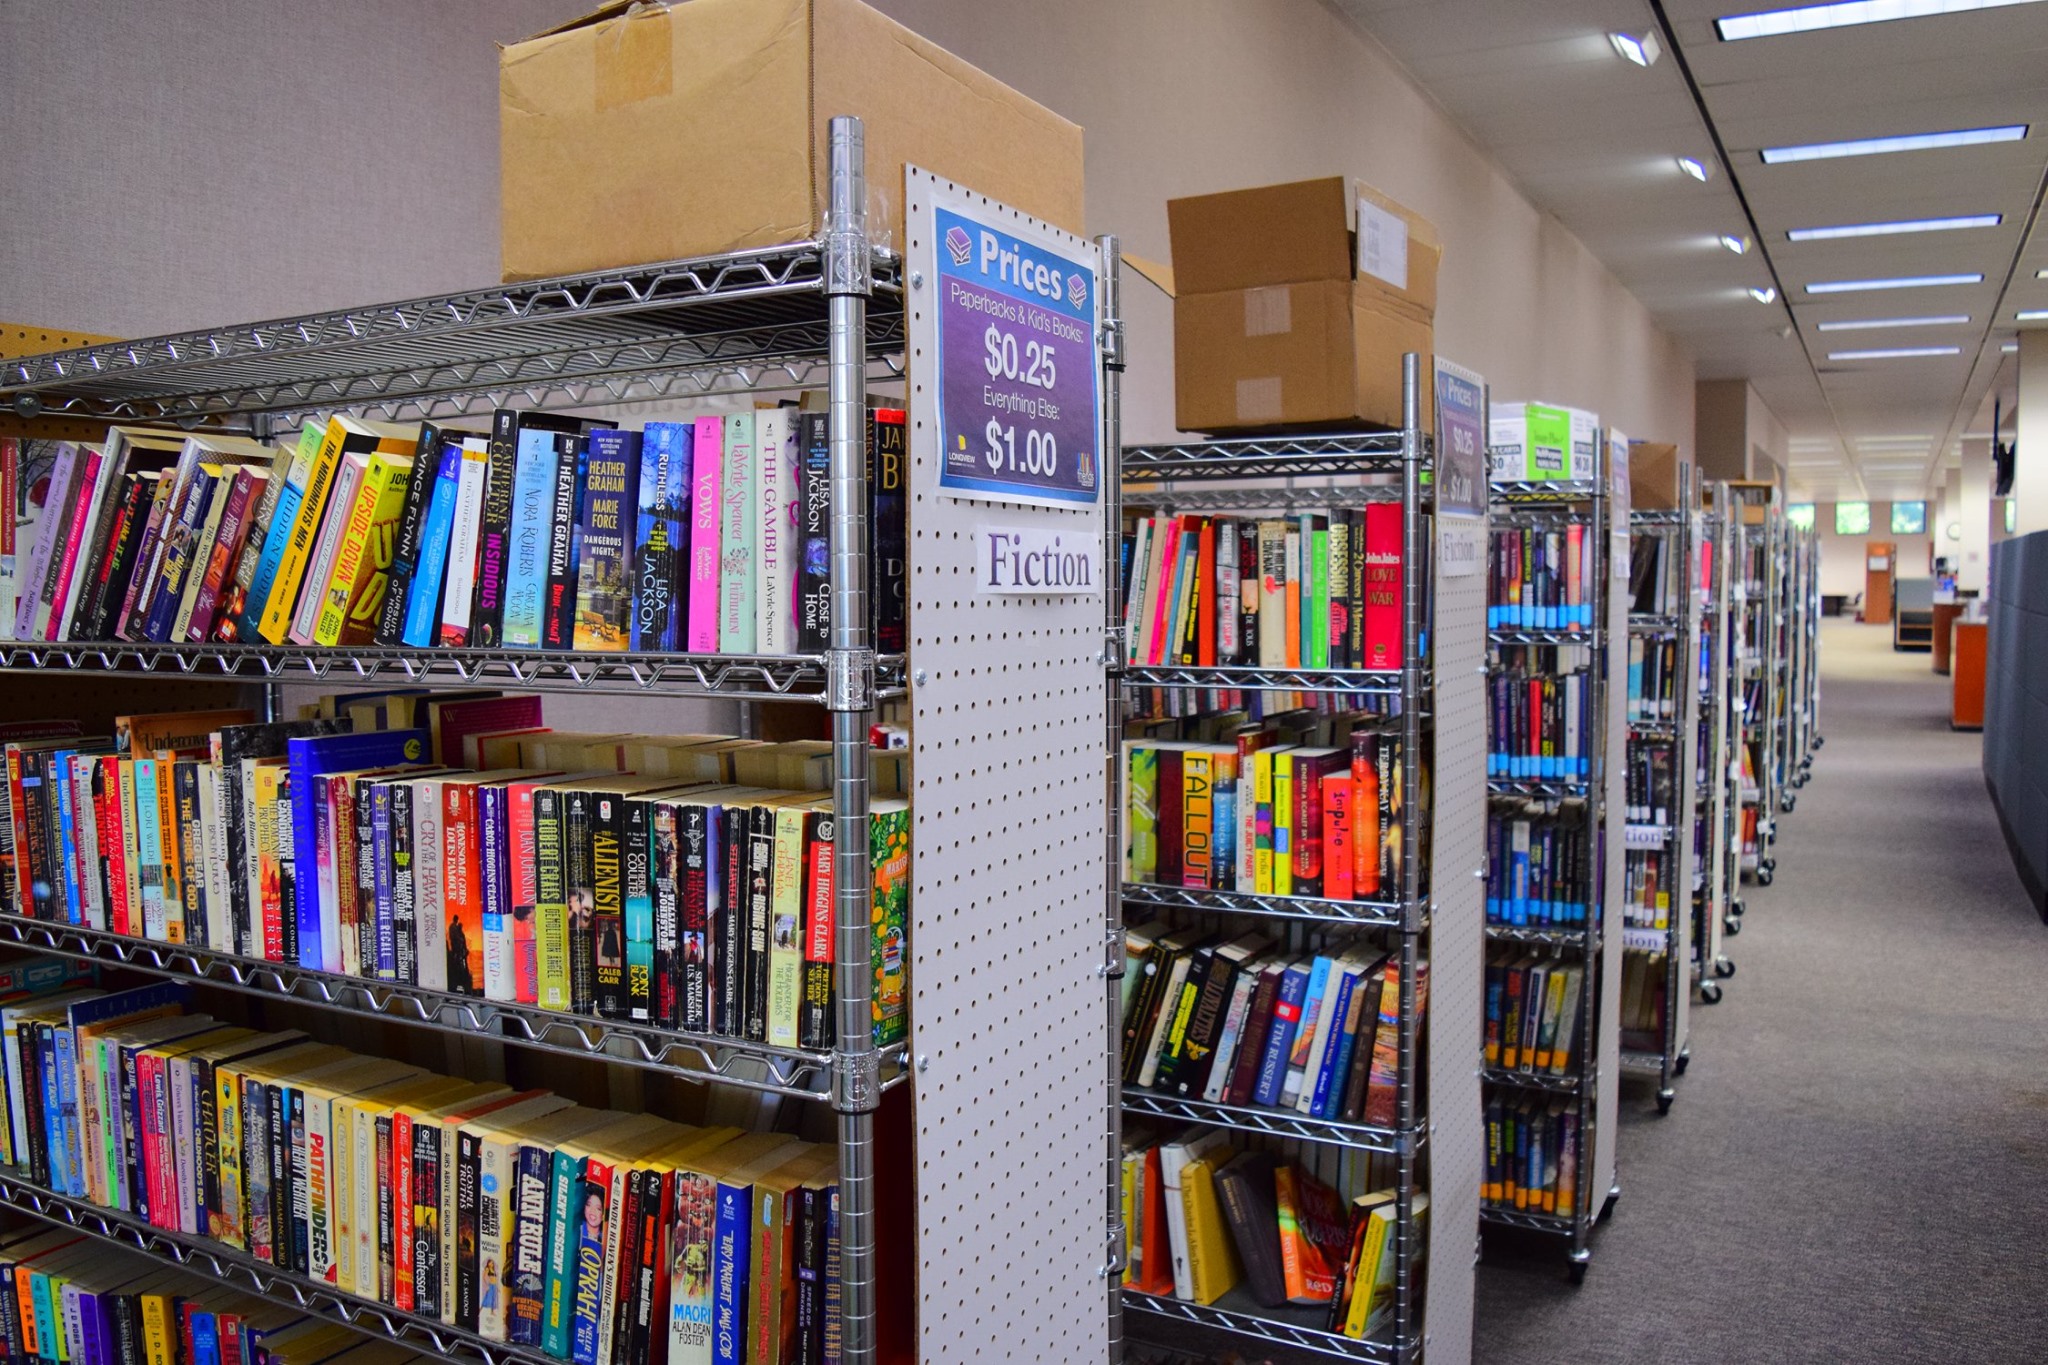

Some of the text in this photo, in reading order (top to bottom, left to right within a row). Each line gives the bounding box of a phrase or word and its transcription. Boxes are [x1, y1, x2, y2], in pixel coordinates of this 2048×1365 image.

[980, 230, 1062, 302] Prices
[951, 283, 1084, 344] Paperbacks & Kid's Books:
[984, 323, 1057, 391] $0.25
[983, 385, 1060, 420] Everything Else:
[1447, 380, 1472, 407] Prices
[294, 433, 316, 483] KEPNES
[948, 452, 976, 464] LONGVIEW
[985, 416, 1057, 477] $1.00
[1452, 427, 1474, 456] $0.25
[486, 441, 502, 524] COULTER
[502, 443, 513, 523] CATHERINE
[588, 461, 626, 477] HEATHER
[588, 476, 626, 492] GRAHAM
[656, 454, 669, 511] RUTHLESS
[1450, 474, 1472, 503] $1.00
[294, 441, 337, 552] THE MONUMENTS MEN
[400, 453, 429, 557] VINCE FLYNN
[592, 500, 620, 515] MARIE
[698, 473, 713, 529] VOWS
[807, 469, 823, 532] JACKSON
[819, 479, 830, 509] LISA
[337, 485, 377, 585] UPSIDE DOWN
[519, 488, 540, 577] NORA ROBERTS
[551, 465, 571, 577] HEATHER GRAHAM
[584, 535, 622, 546] DANGEROUS
[592, 514, 619, 530] FORCE
[764, 443, 777, 648] THE GAMBLE LaVyrle Spencer
[253, 494, 297, 613] HIDDEN BODIES
[482, 533, 500, 609] INSIDIOUS
[592, 546, 615, 556] NIGHTS
[987, 533, 1091, 587] Fiction
[1263, 540, 1274, 575] COVENANT
[1330, 523, 1349, 597] OBSESSION
[1366, 552, 1400, 564] John Jakes
[1443, 532, 1475, 562] Fiction
[640, 553, 656, 634] JACKSON
[655, 579, 668, 611] LISA
[1367, 568, 1398, 583] LOVE
[1368, 591, 1395, 605] WAR
[319, 611, 330, 632] MILLER
[323, 614, 335, 640] RAMSEY
[331, 617, 341, 637] JOHN
[382, 579, 400, 638] OF HONOR
[389, 587, 404, 635] PURSUIT
[804, 594, 818, 630] HOME
[818, 583, 831, 623] CLOSE
[1379, 745, 1389, 814] TERRY KAY
[144, 804, 155, 863] LORI WILDE
[158, 765, 172, 861] MODERN SPANISH THEATRE
[259, 806, 270, 855] PROPHECY
[1186, 757, 1208, 886] FALLOUT
[191, 819, 205, 888] GREG BEAR
[270, 818, 280, 862] ROMANOV
[538, 818, 560, 900] ROBERT CRAIS
[1219, 847, 1226, 857] AS
[1260, 851, 1269, 875] India
[485, 818, 497, 913] CAROL HIGGINS CLARK
[519, 829, 536, 904] JOAN JOHNSTON
[594, 834, 620, 917] ALIENIST
[628, 853, 638, 898] COULTER
[637, 853, 647, 898] CATHERINE
[775, 839, 787, 898] CHAPMAN
[785, 856, 796, 889] JANET
[1218, 860, 1226, 879] THIS
[1246, 854, 1254, 879] PARTS
[288, 888, 297, 958] RICHARD CONDON
[752, 894, 766, 952] RISING SUN
[812, 845, 832, 960] MARY HIGGINS CLARK
[266, 903, 277, 957] BERRY
[275, 903, 284, 955] STEVE
[598, 967, 622, 976] CALEB
[598, 975, 619, 985] CARR
[630, 964, 640, 996] BLANK
[640, 964, 649, 997] POINT
[1259, 1023, 1286, 1098] TIM RUSSERT
[201, 1090, 217, 1175] CHAUCER
[309, 1132, 328, 1265] PATHFINDERS
[459, 1163, 467, 1209] TRUTHS
[519, 1174, 545, 1275] ANN RULE
[552, 1174, 569, 1275] SILENT DESCENT
[416, 1240, 429, 1298] Confessor
[428, 1252, 436, 1266] The
[443, 1244, 451, 1259] Mary
[443, 1261, 451, 1286] Stewart
[603, 1198, 619, 1308] UNDER HEAVEN'S BRIDGE
[720, 1230, 735, 1305] TERRY PRATCHETT
[577, 1246, 601, 1322] OPRAH!
[578, 1327, 586, 1345] BLY
[672, 1321, 711, 1333] ALAN DEAN
[673, 1303, 711, 1323] MAORI
[584, 1323, 594, 1353] NELLIE
[678, 1333, 705, 1347] FOSTER
